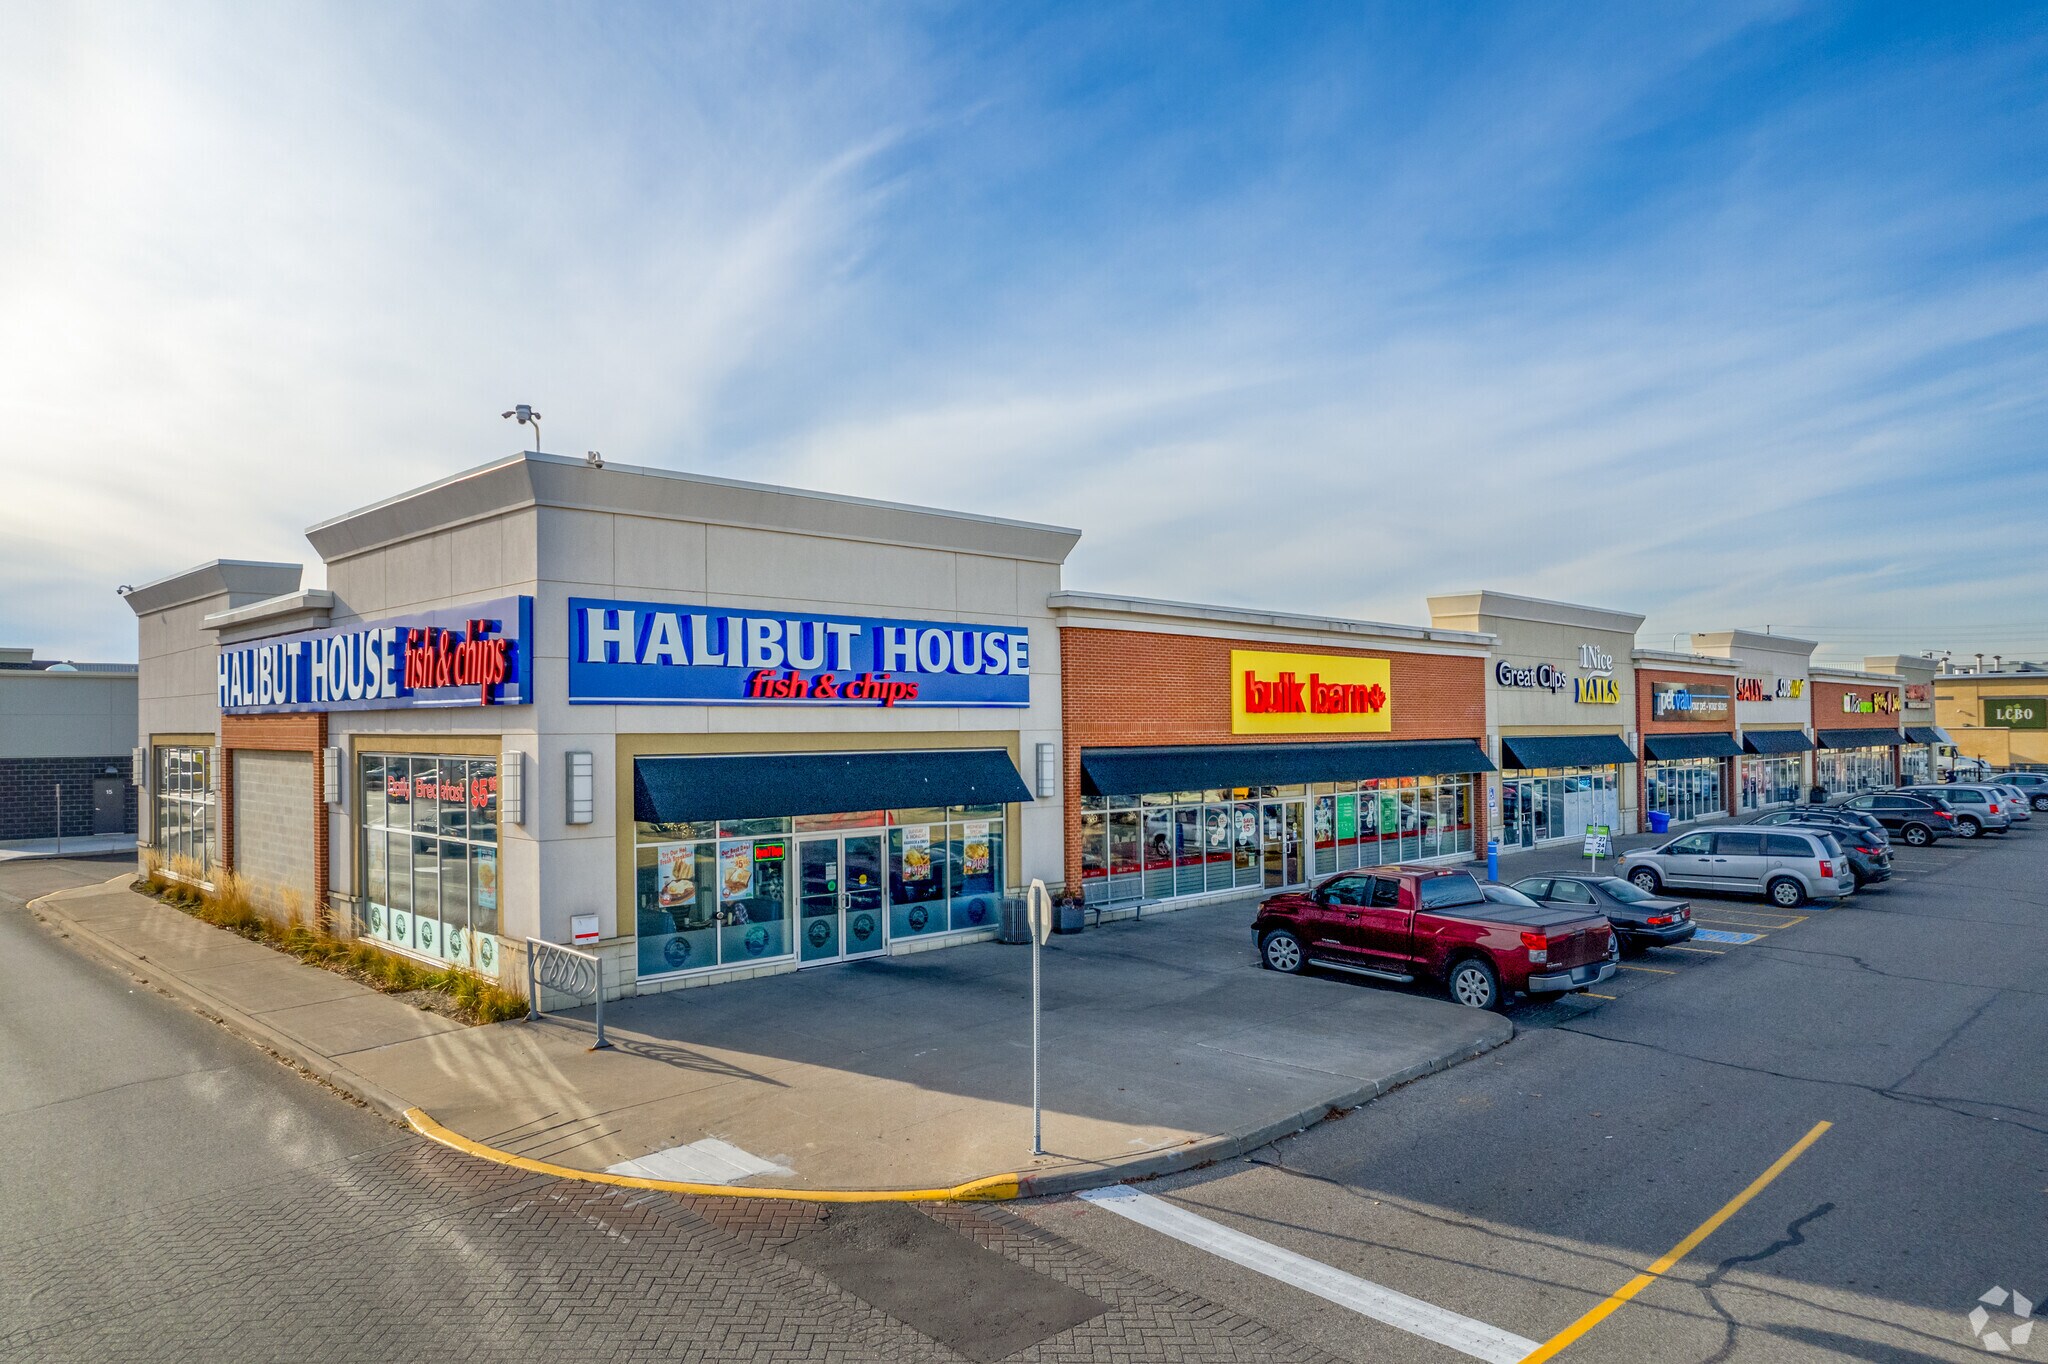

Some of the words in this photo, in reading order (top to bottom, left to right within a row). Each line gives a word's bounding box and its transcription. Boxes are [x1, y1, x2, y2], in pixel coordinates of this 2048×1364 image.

[587, 607, 861, 671] HALIBUT
[883, 626, 1030, 677] HOUSE
[217, 642, 301, 708] HALIBUT
[311, 626, 396, 702] HOUSE
[404, 625, 434, 690] fish
[435, 629, 451, 688] &
[453, 619, 506, 707] chips
[1497, 660, 1536, 687] Great
[1538, 663, 1567, 695] Clips
[749, 670, 808, 700] fish
[815, 674, 841, 698] &
[845, 672, 919, 708] chips
[1245, 670, 1307, 713] bulk
[1310, 673, 1369, 713] barn
[1578, 678, 1621, 705] NAILS
[1657, 689, 1675, 715] pet
[1737, 677, 1763, 701] SALLY
[1996, 708, 2033, 720] LCBO
